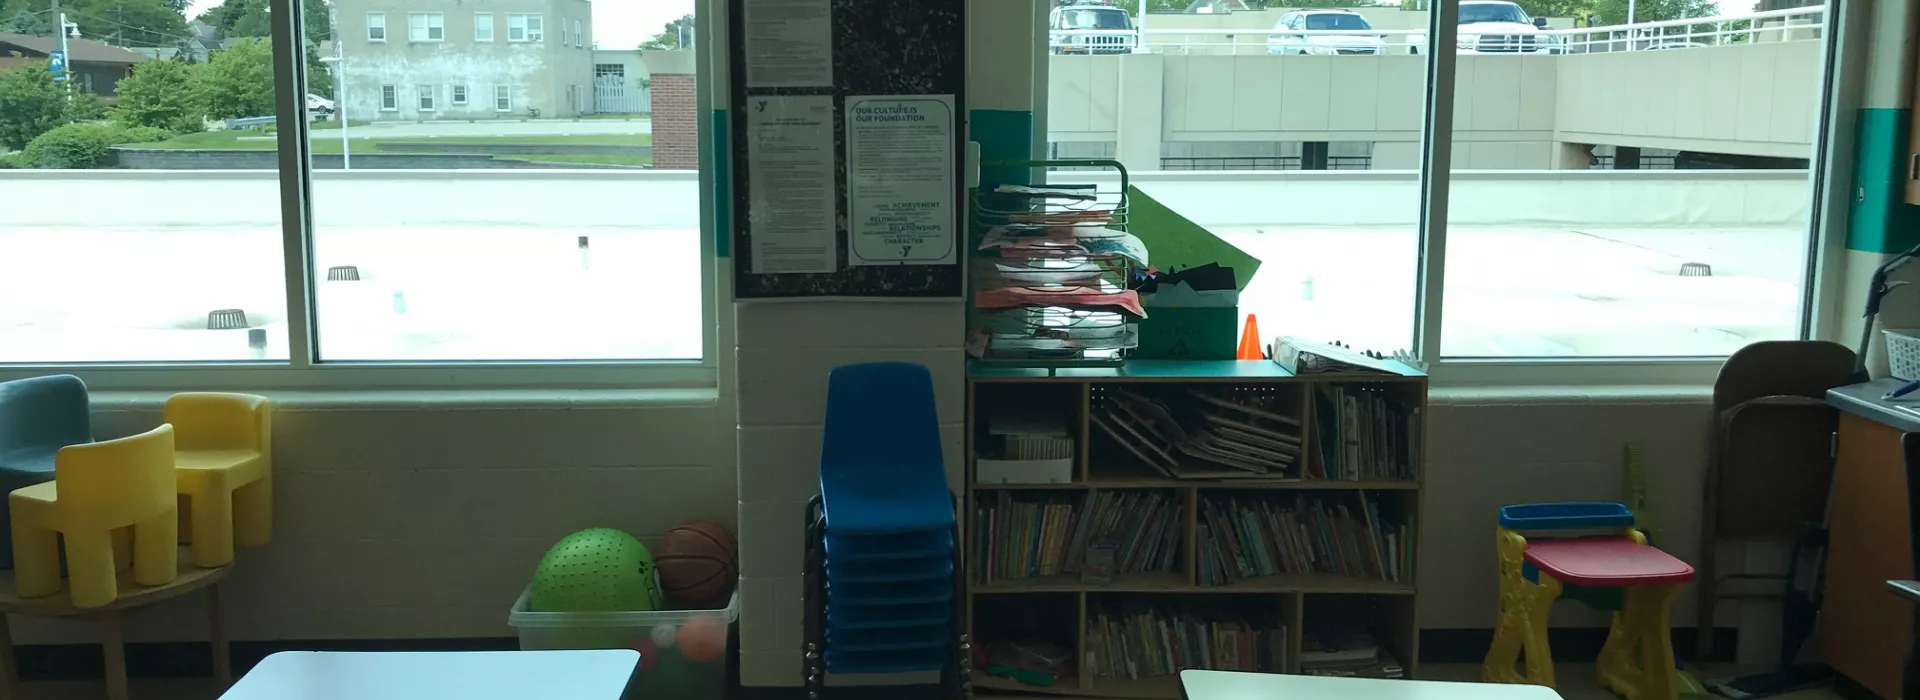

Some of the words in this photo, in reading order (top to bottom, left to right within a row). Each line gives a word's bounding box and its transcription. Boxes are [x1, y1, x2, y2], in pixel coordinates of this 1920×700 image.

[856, 107, 872, 115] OUR
[874, 107, 909, 115] CULTURE
[874, 114, 925, 122] FOUNDATION
